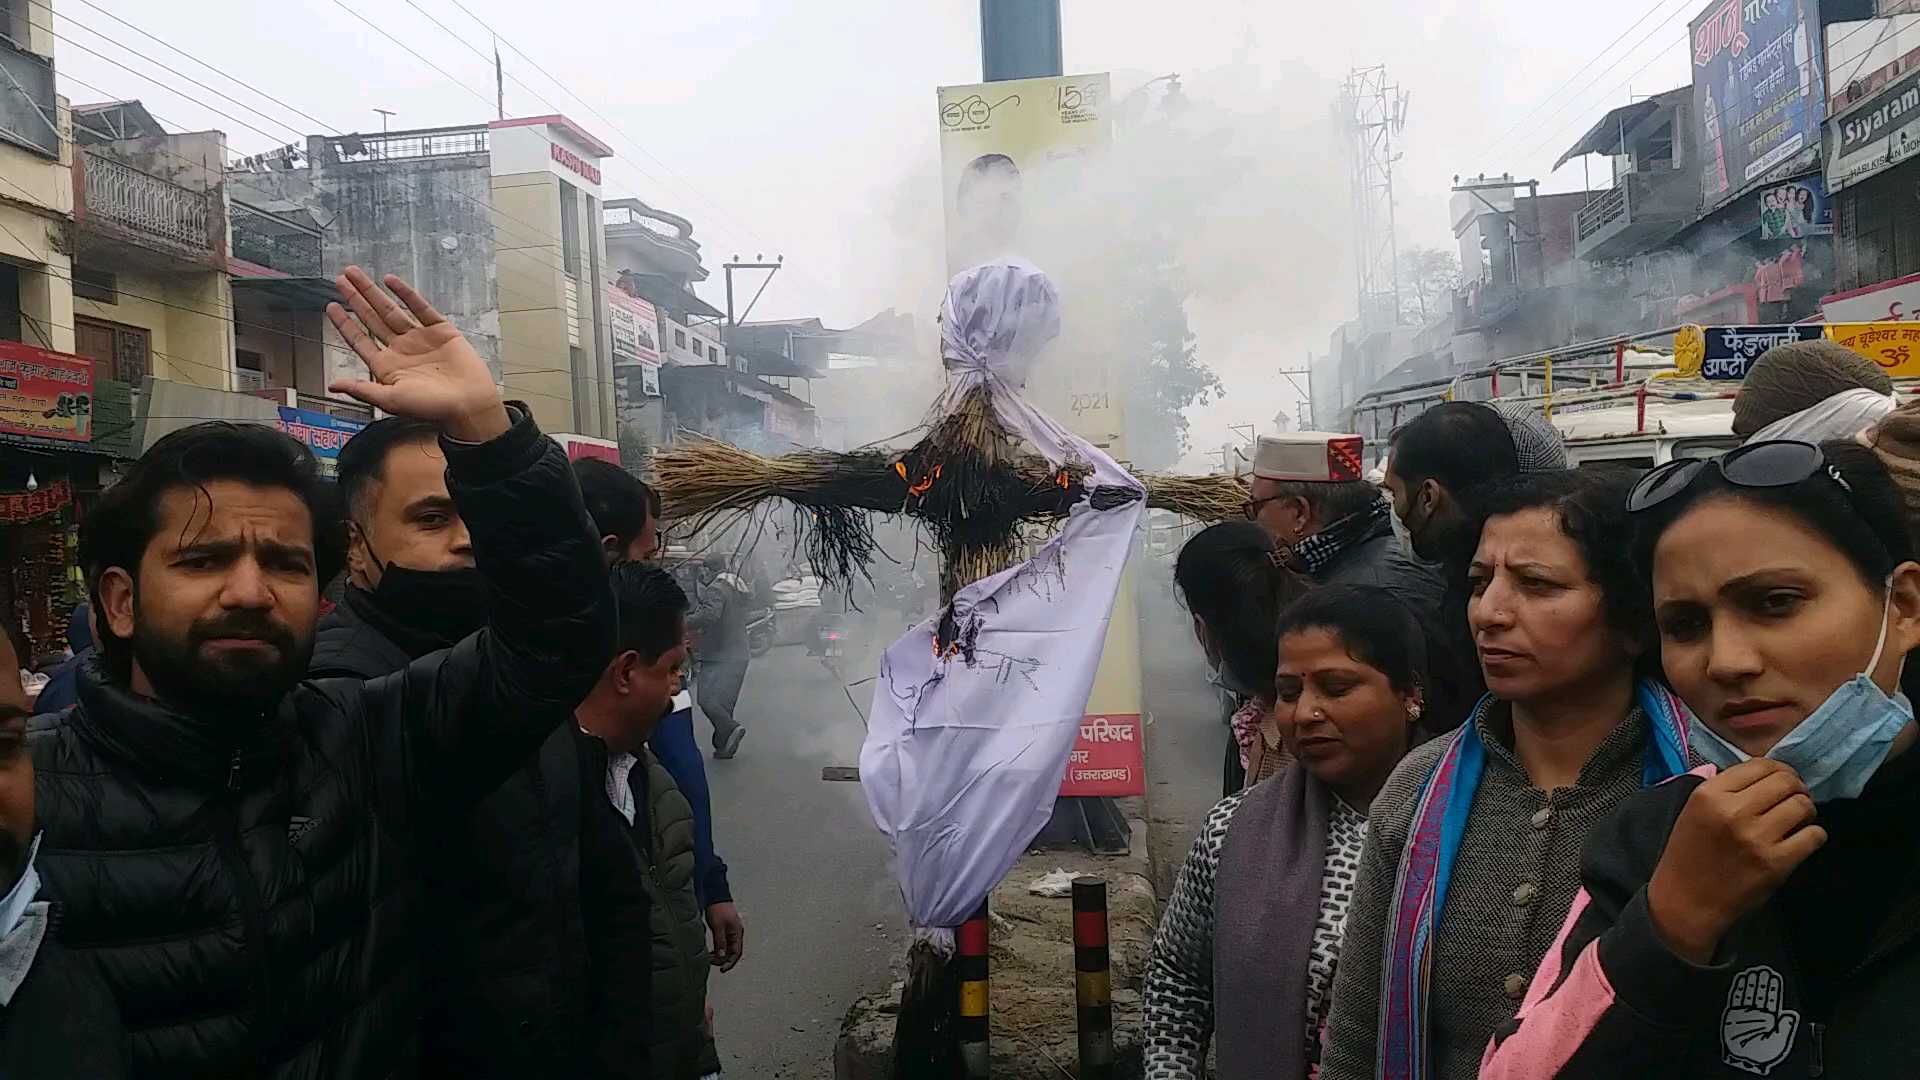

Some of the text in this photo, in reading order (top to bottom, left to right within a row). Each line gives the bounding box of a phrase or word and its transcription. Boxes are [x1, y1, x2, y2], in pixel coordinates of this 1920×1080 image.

[1080, 718, 1134, 742] परिषद
[1070, 750, 1089, 764] गर
[1070, 765, 1132, 784] (उत्तराखण्ड)
